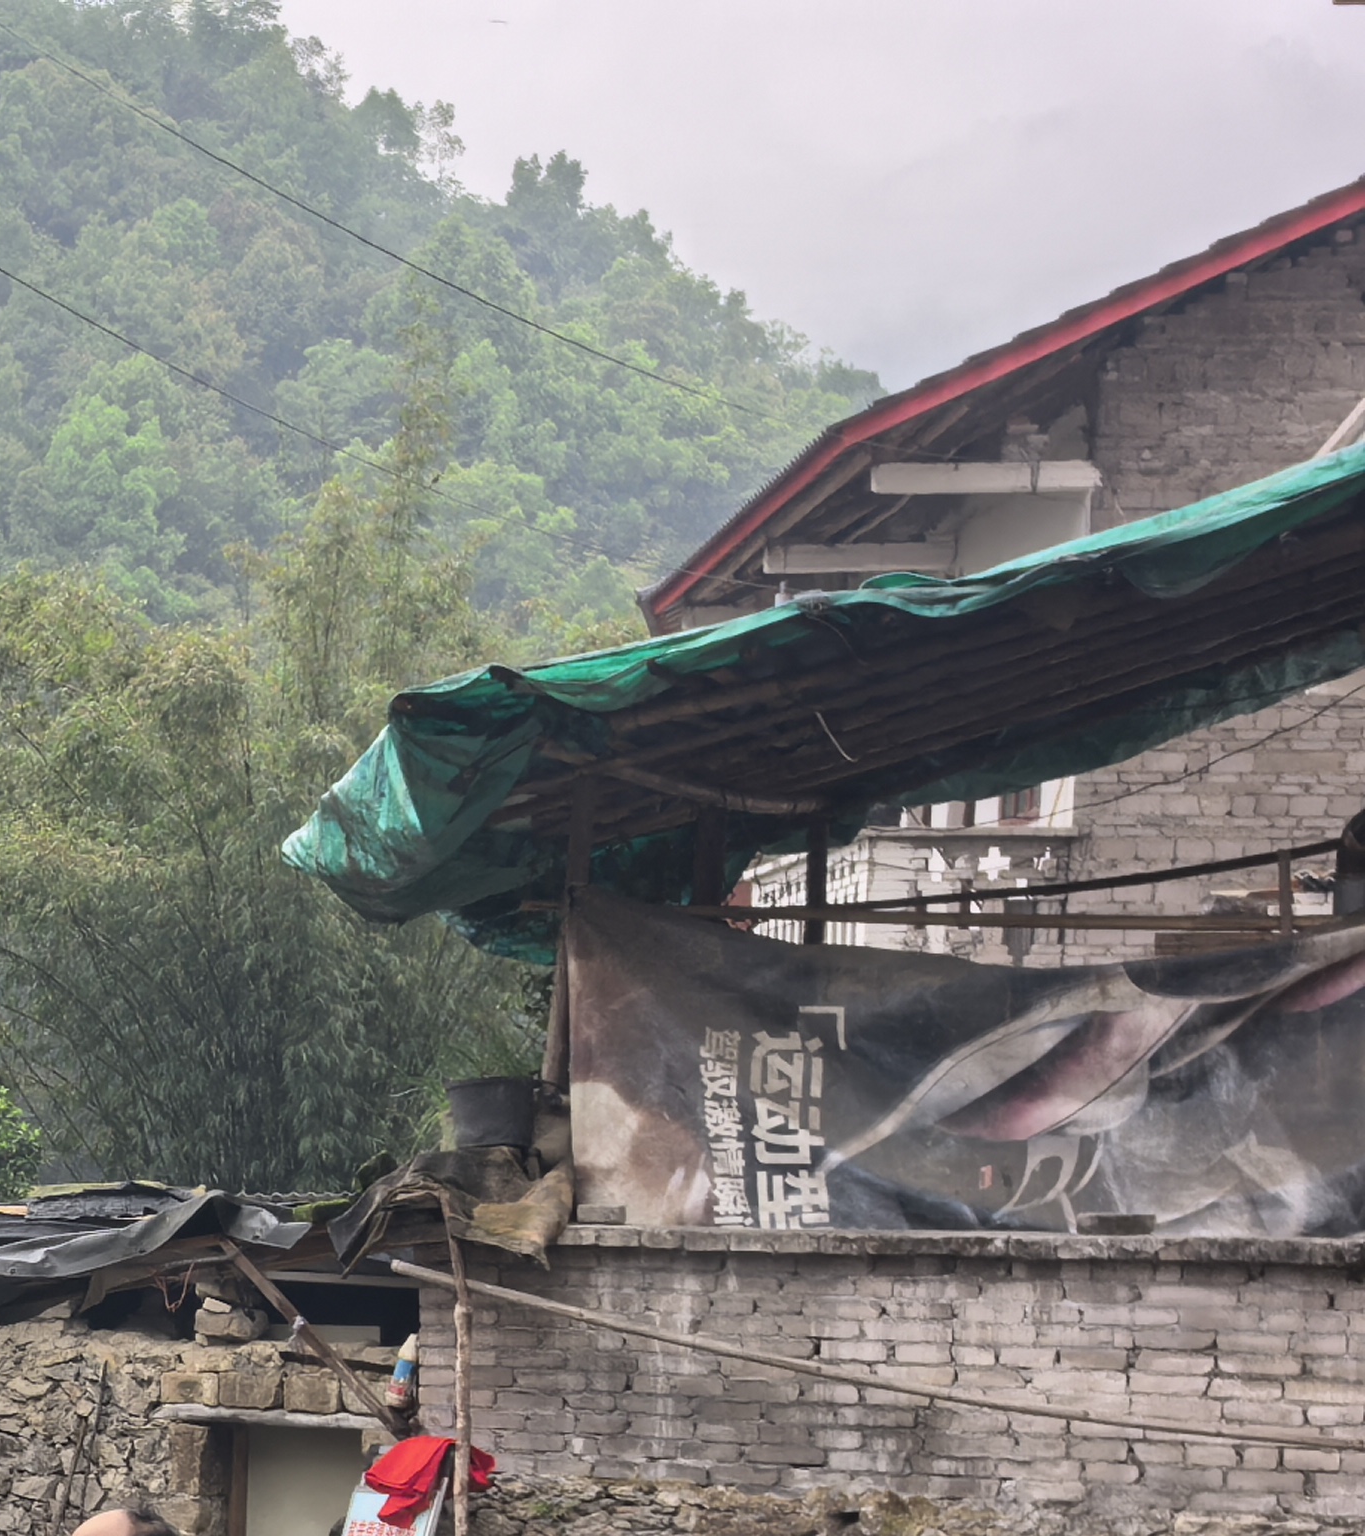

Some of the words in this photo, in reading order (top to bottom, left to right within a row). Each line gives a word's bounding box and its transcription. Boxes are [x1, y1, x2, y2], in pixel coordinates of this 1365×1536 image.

[699, 1027, 754, 1228] 驾驭激情瞬
